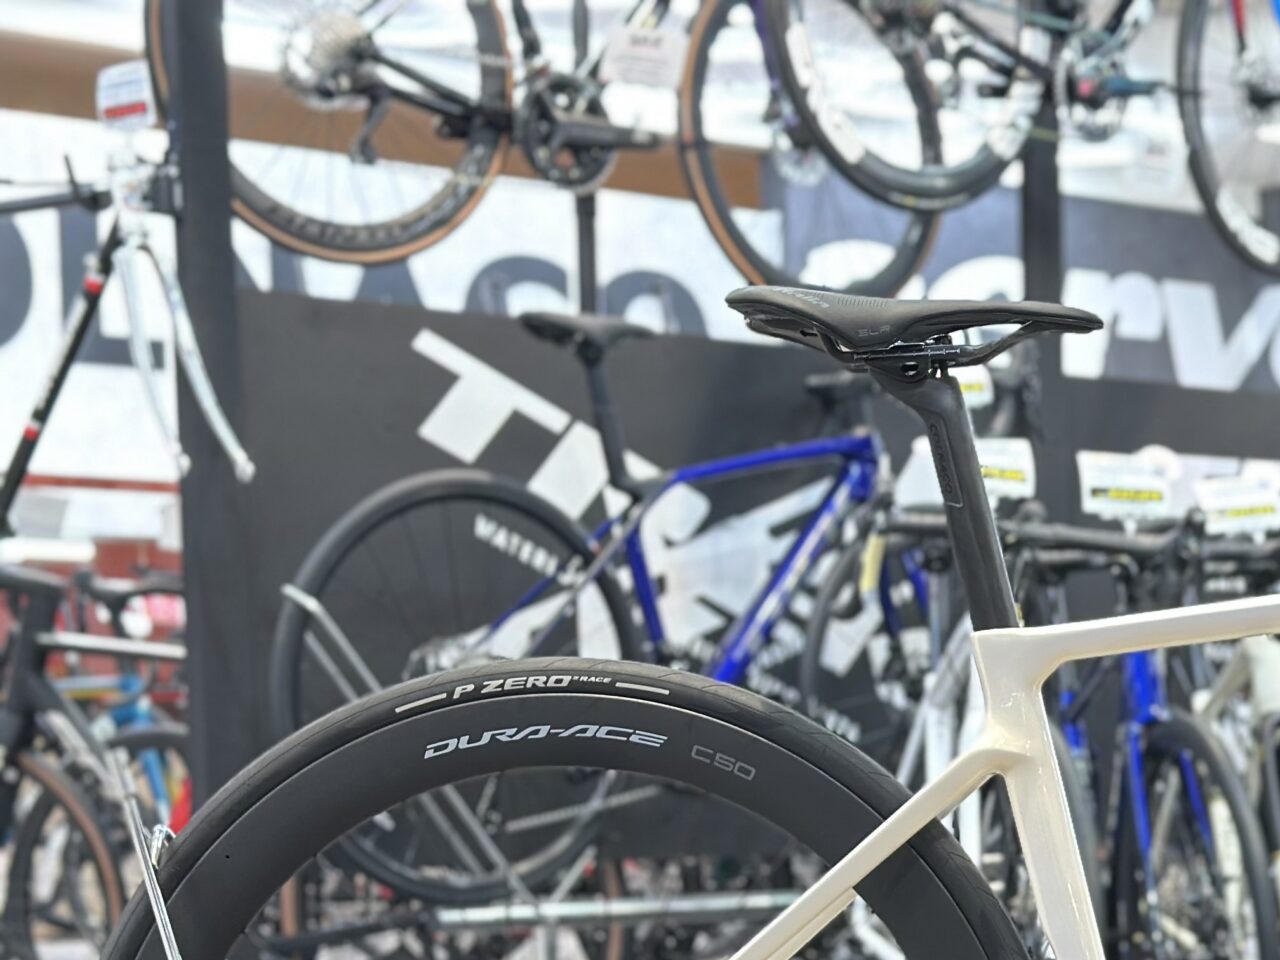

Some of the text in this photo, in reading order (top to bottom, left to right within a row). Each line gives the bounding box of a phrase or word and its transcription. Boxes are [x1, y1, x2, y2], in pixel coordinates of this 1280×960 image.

[858, 324, 891, 338] SLR
[452, 683, 475, 699] P
[480, 675, 572, 694] ZERO
[424, 724, 756, 781] DURA-ACE C50
